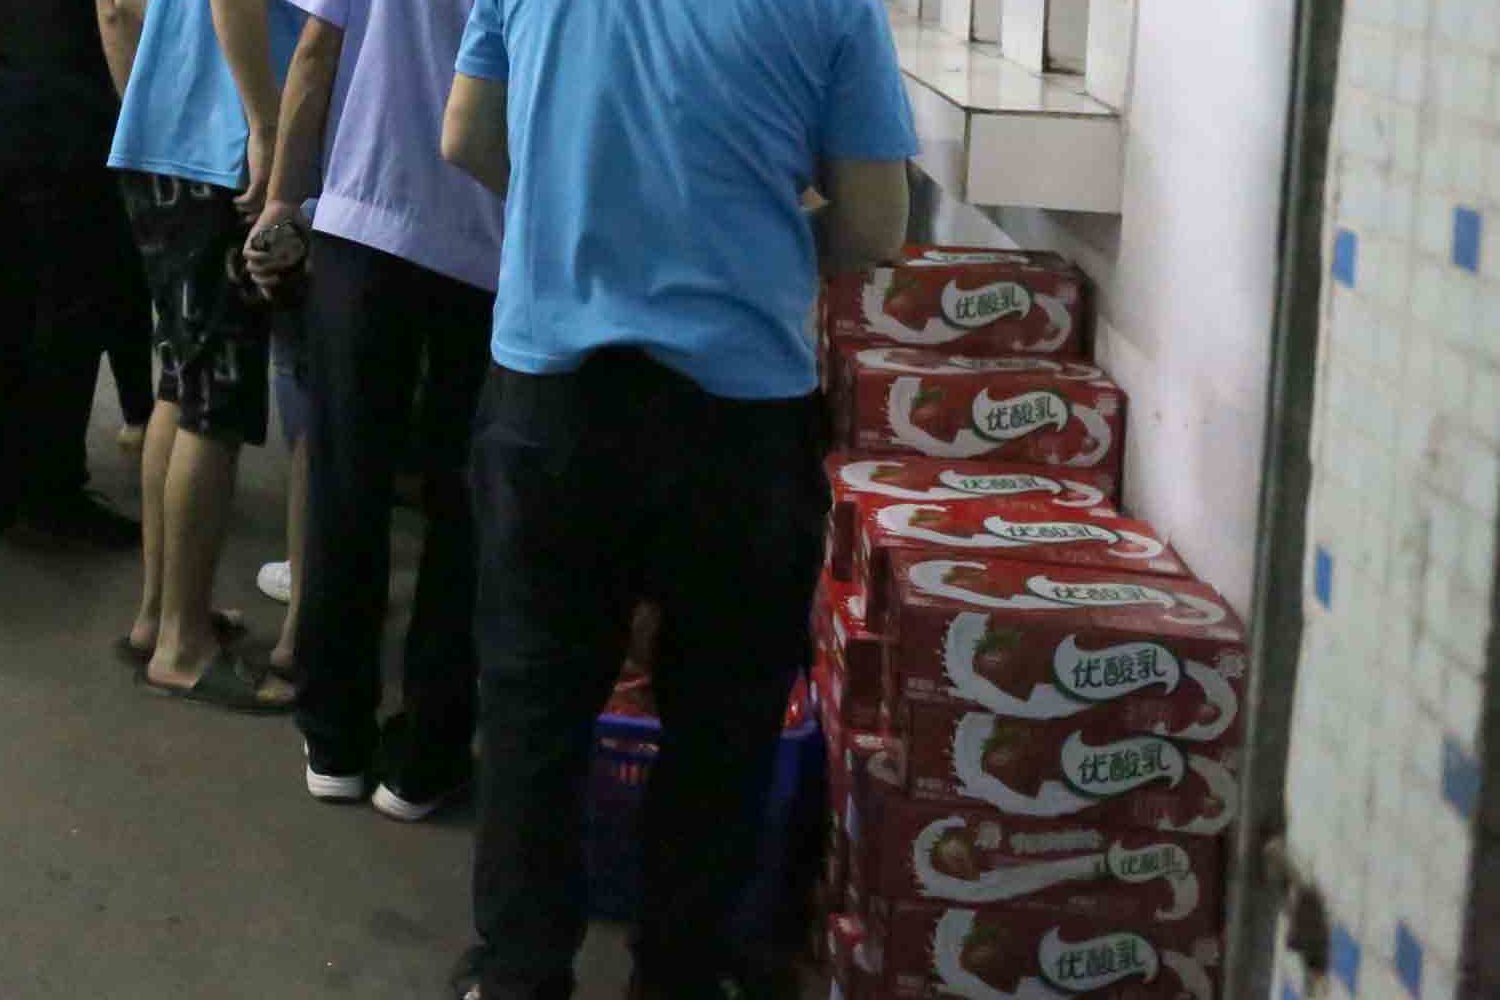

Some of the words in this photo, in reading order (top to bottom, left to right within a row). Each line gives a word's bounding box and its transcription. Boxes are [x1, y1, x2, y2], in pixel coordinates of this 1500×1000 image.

[955, 286, 1020, 319] 优酸乳
[986, 398, 1058, 431] 优酸乳
[1070, 656, 1168, 688] 优酸乳
[1077, 750, 1171, 785] 优酸乳
[1055, 942, 1147, 980] 优酸乳
